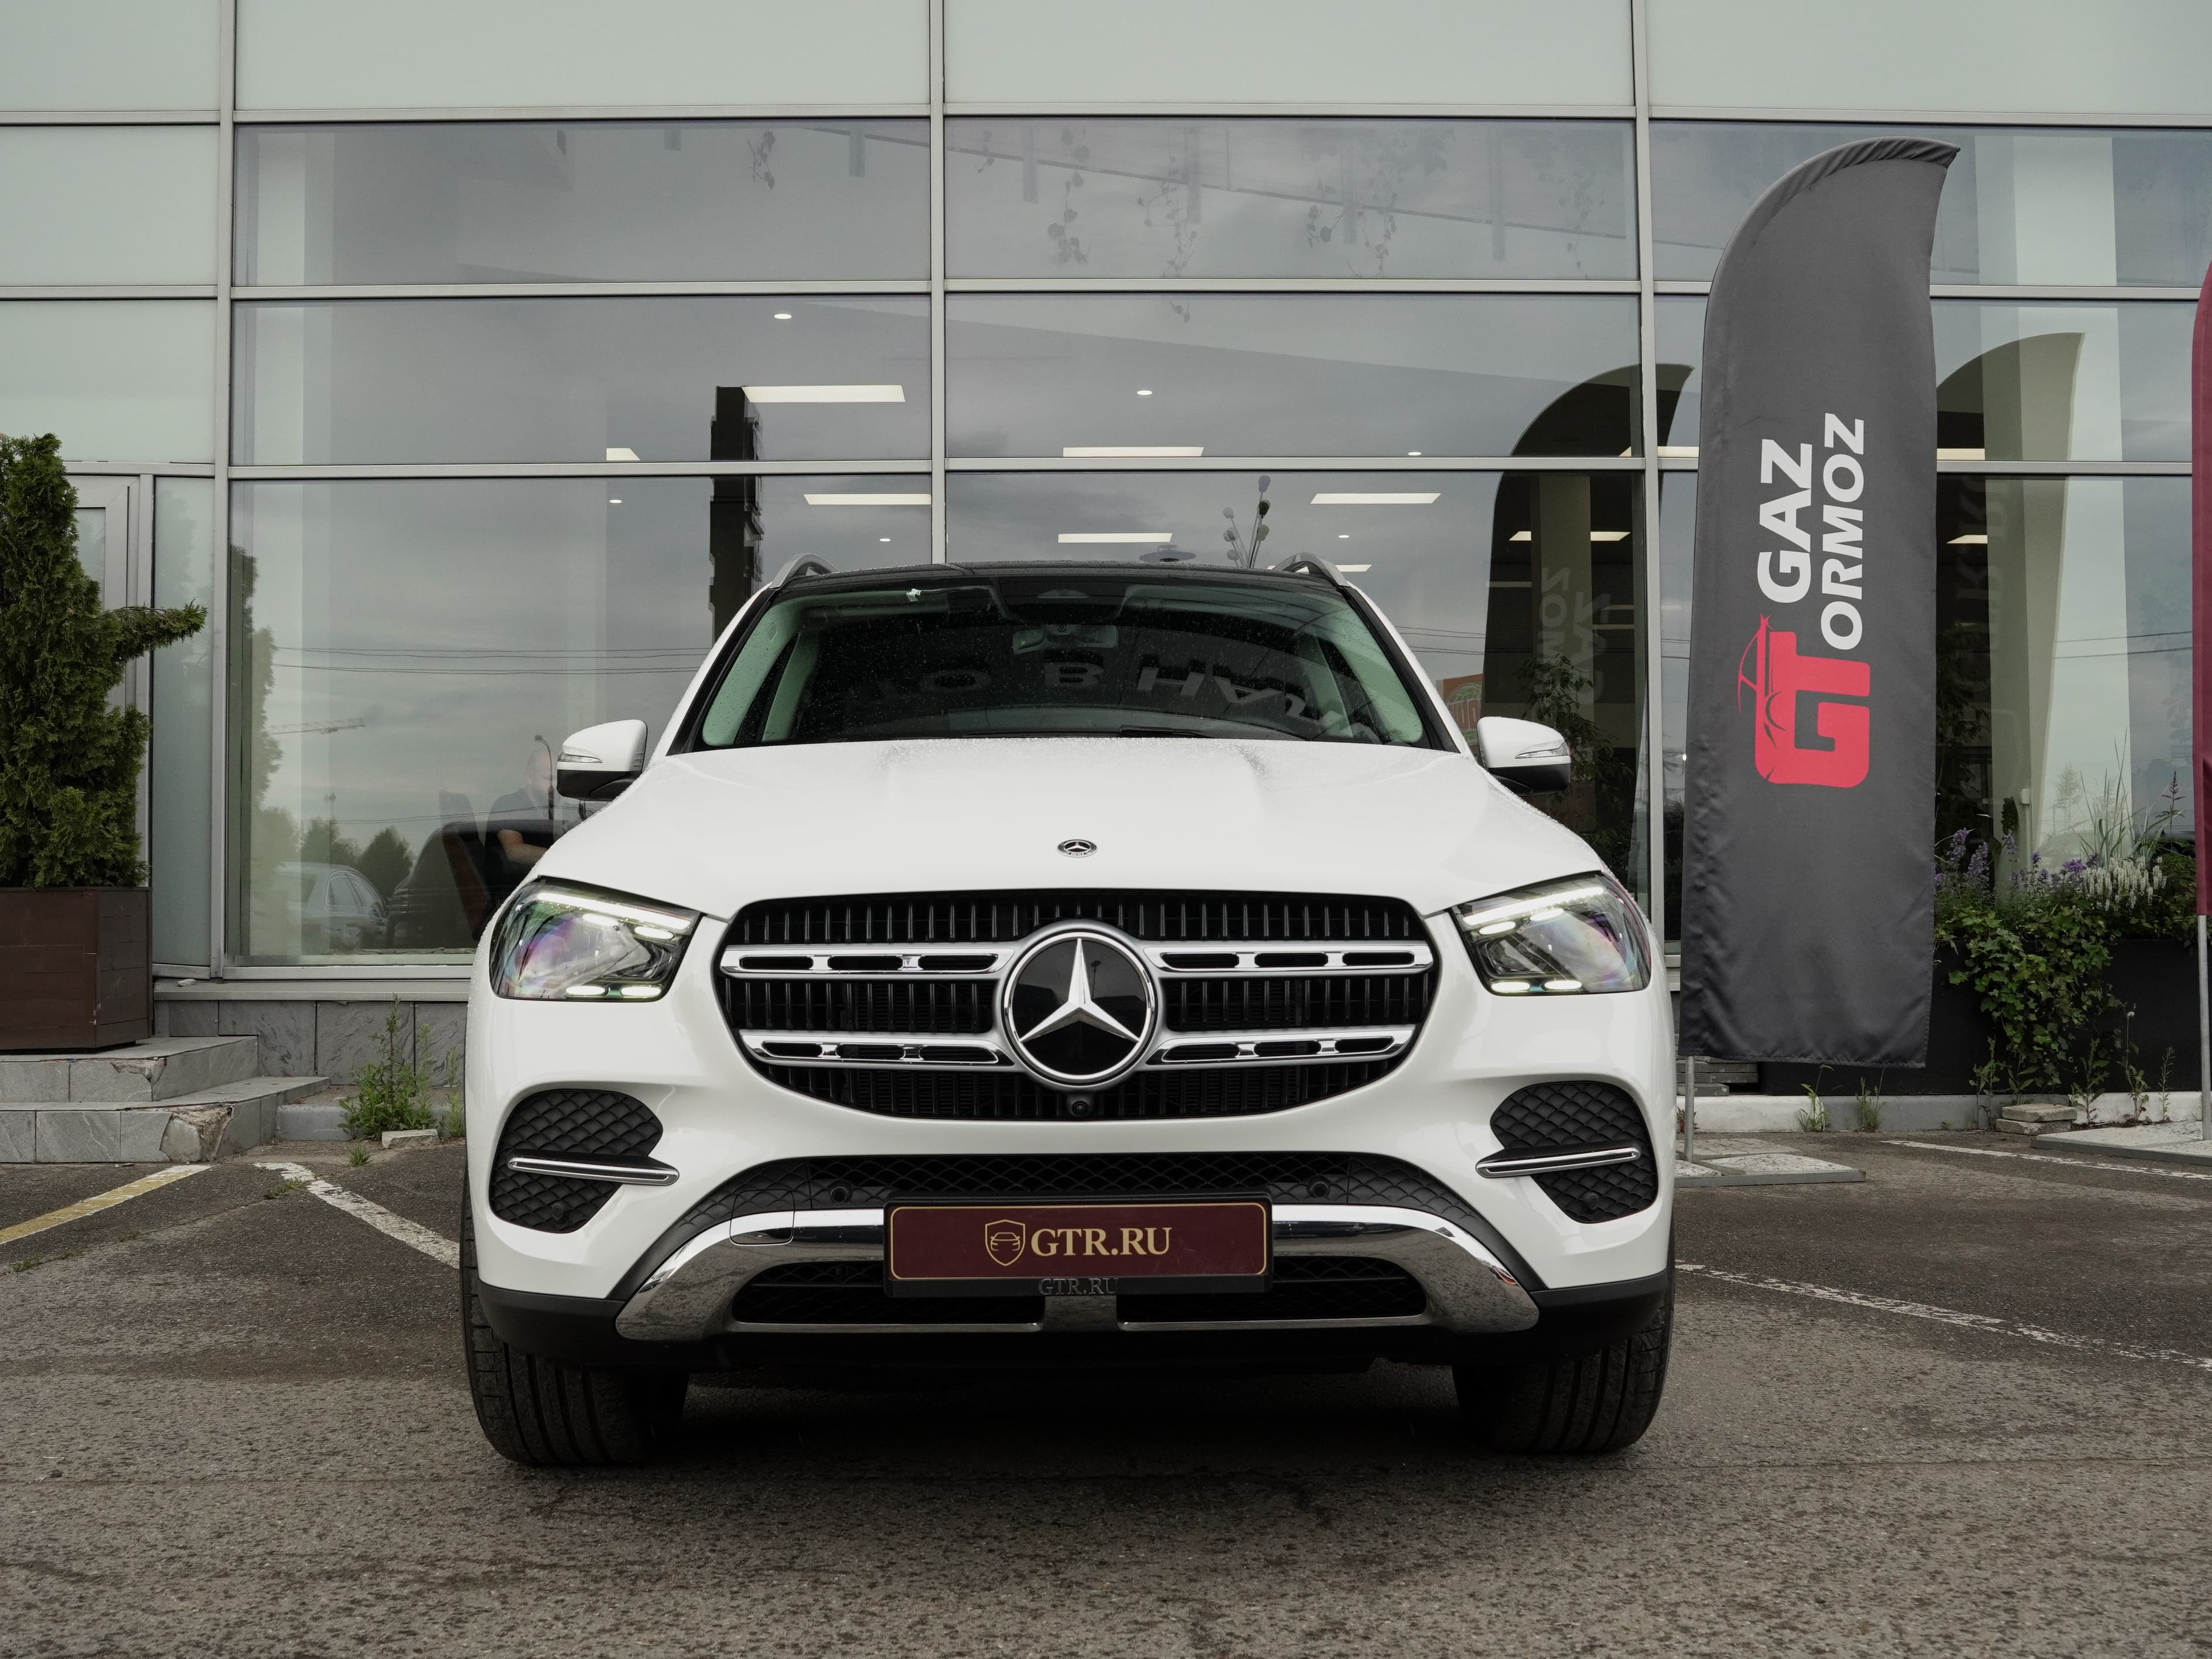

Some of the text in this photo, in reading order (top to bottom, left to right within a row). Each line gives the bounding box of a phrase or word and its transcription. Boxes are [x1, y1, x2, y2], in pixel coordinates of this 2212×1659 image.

[1757, 439, 1812, 603] GAZ
[1821, 412, 1865, 650] ORMOZ
[1030, 1227, 1172, 1257] GTR.RU
[1037, 1277, 1119, 1295] GTR.RU
